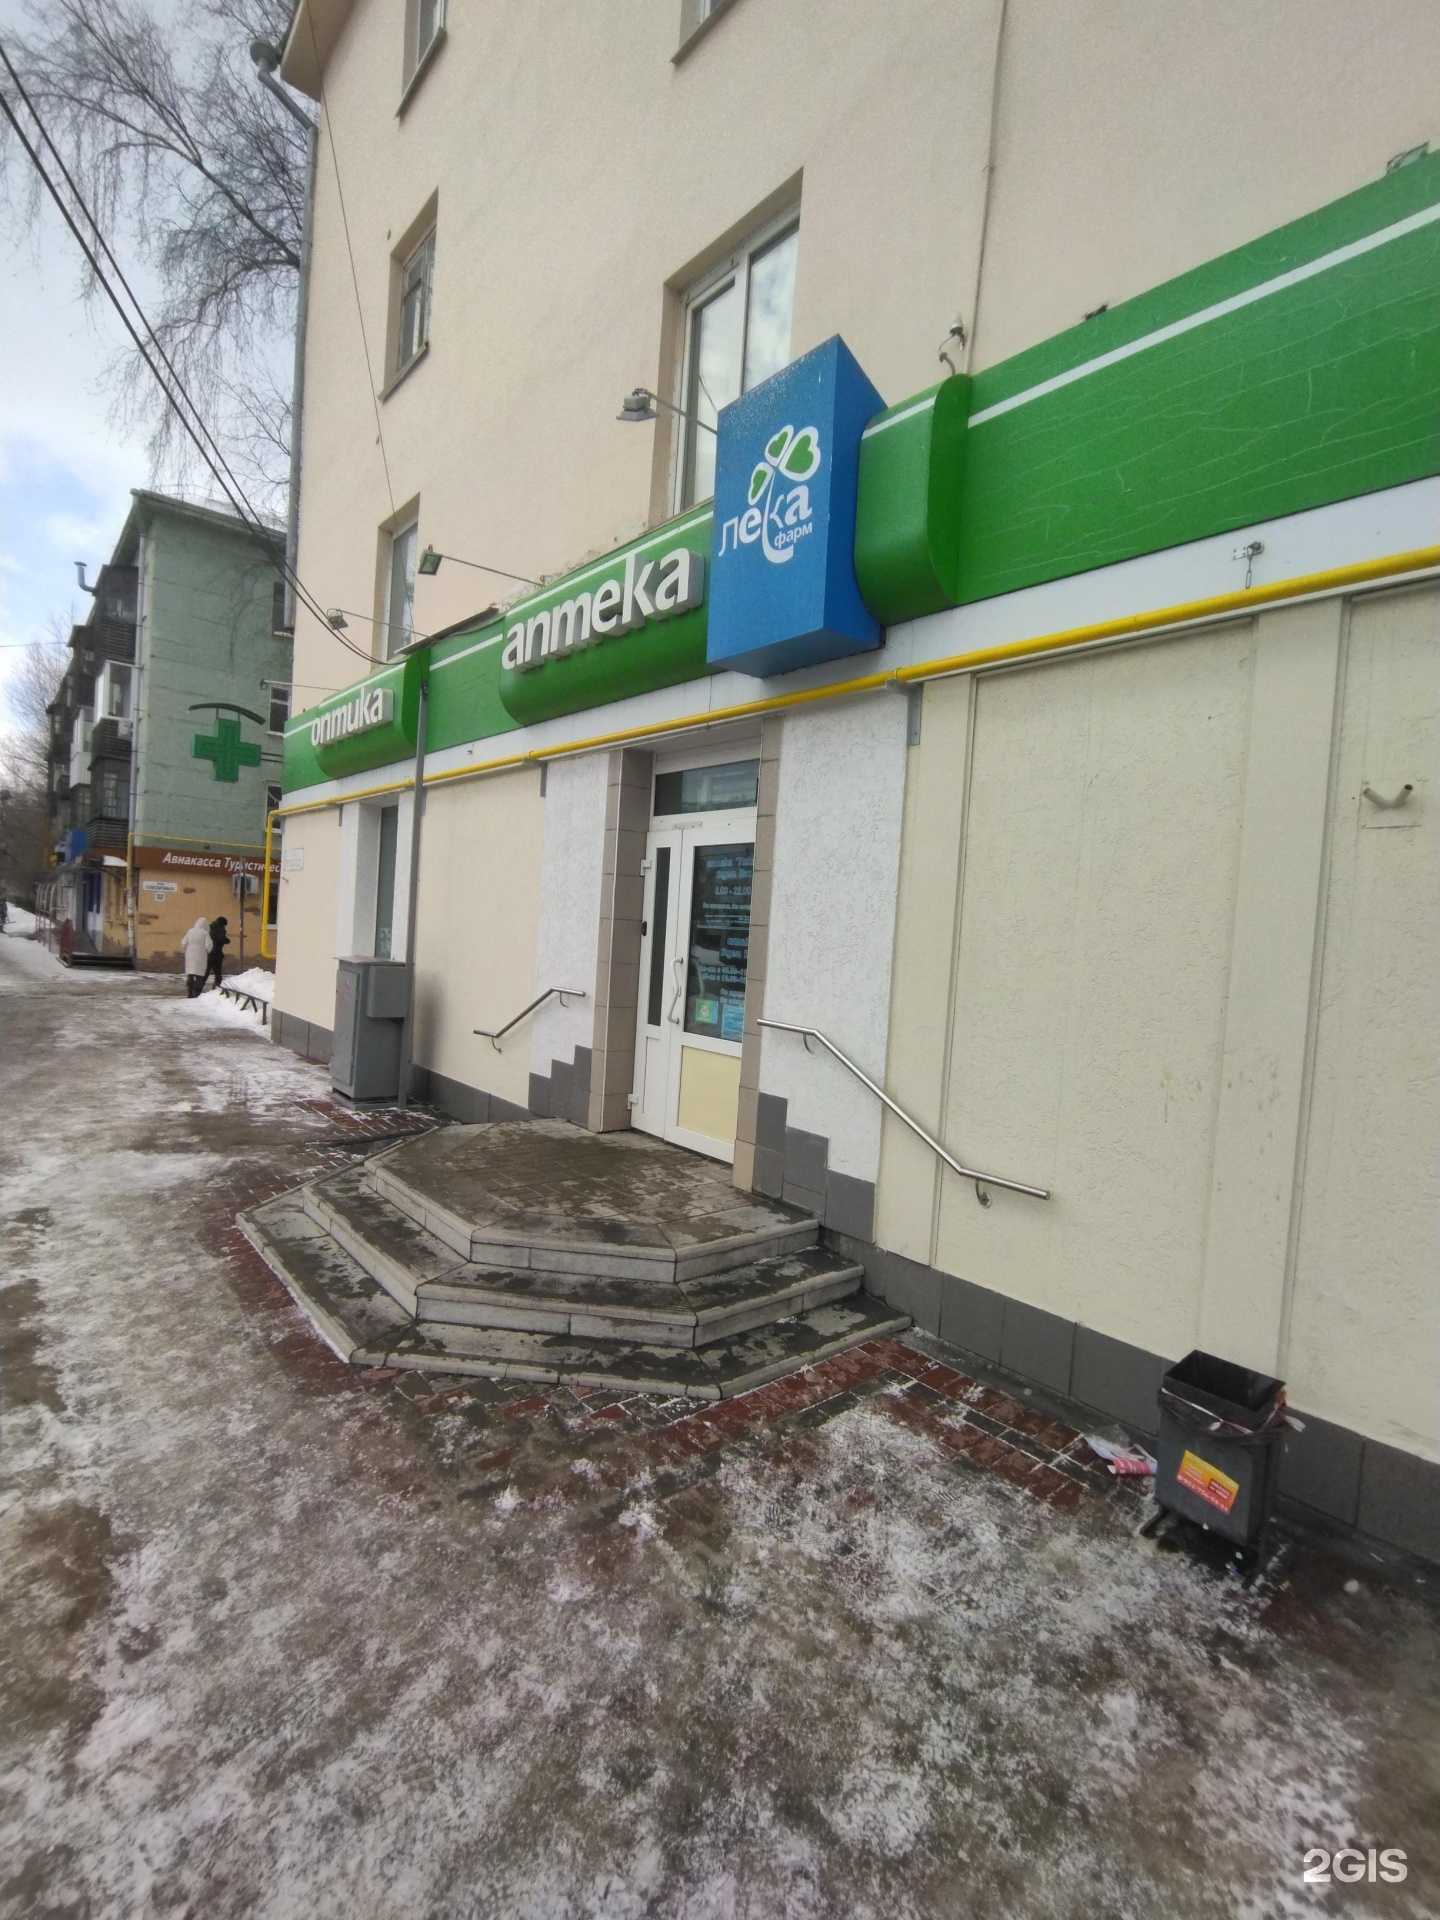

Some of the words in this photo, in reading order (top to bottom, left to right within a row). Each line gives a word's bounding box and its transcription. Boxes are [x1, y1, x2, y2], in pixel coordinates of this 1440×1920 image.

[774, 522, 813, 549] фарм
[501, 547, 692, 670] аптека
[311, 687, 384, 746] оптика
[162, 852, 221, 868] Авиакасса
